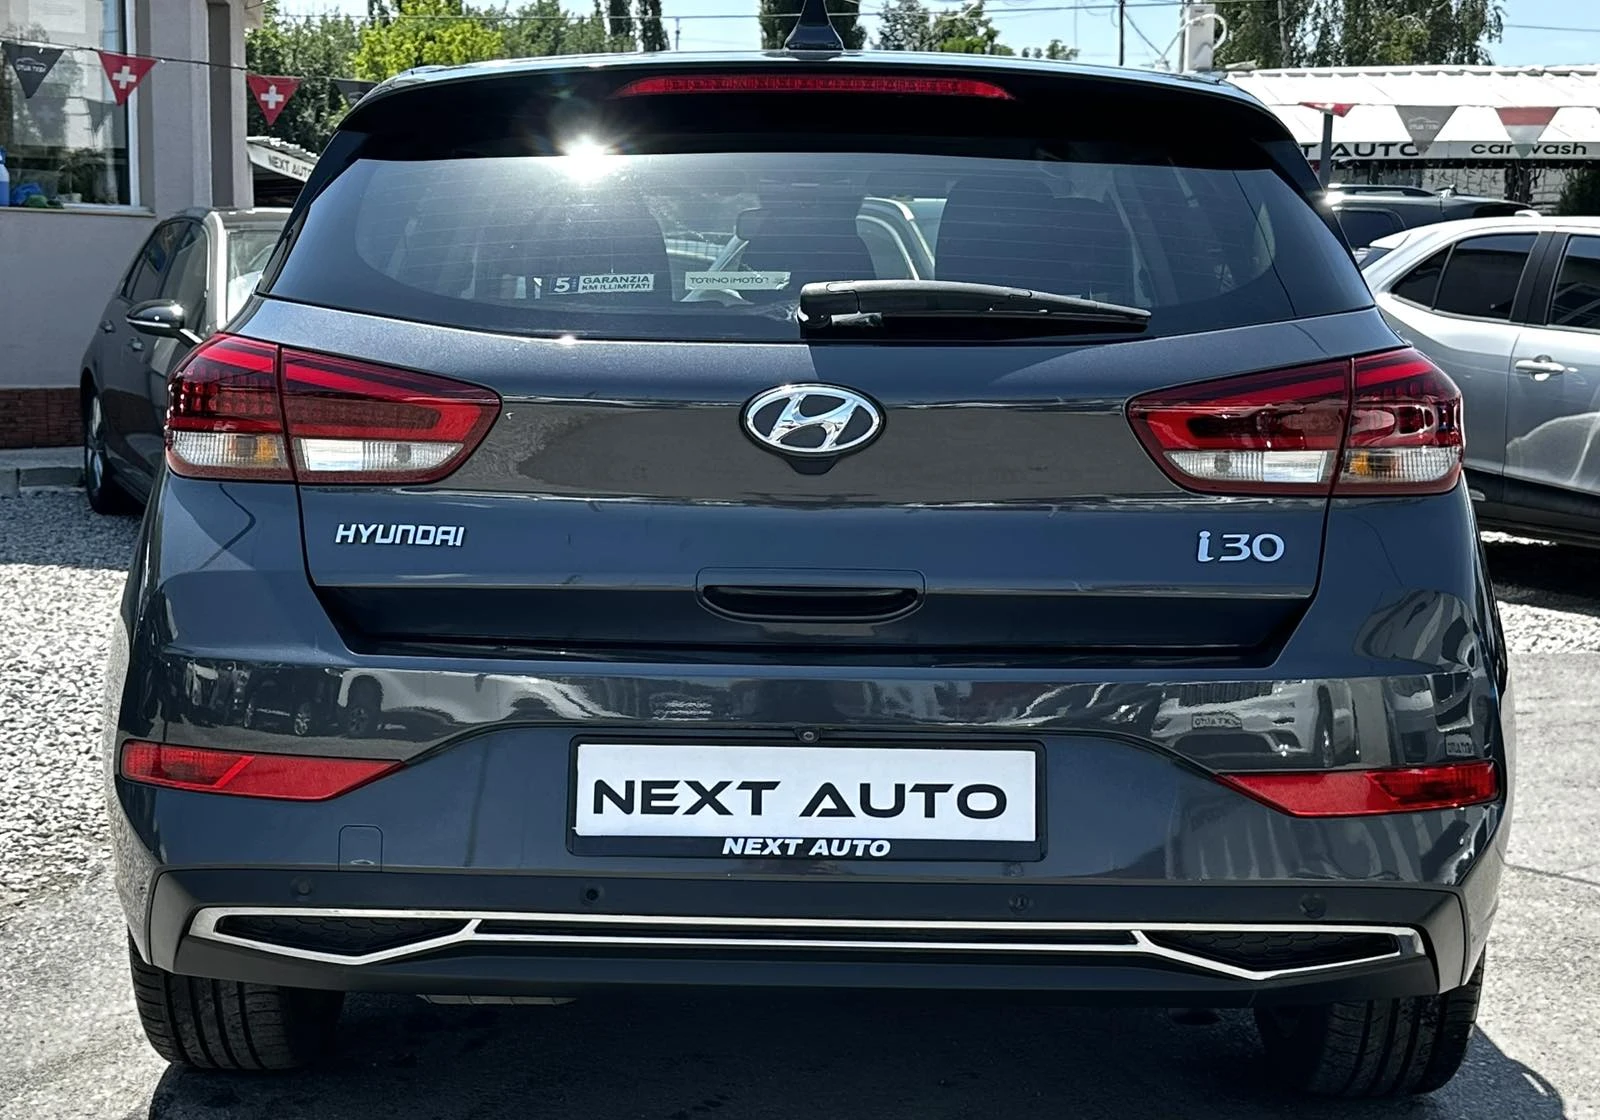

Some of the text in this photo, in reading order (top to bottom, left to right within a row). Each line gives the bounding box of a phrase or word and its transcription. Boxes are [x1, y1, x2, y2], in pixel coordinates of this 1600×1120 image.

[1331, 143, 1419, 157] AUTO
[1471, 143, 1514, 155] car
[553, 277, 571, 293] 5
[582, 275, 650, 285] GARANZIA
[689, 276, 729, 285] TORINO
[335, 523, 465, 546] HYUNDAI
[1197, 530, 1285, 562] i30
[593, 778, 1008, 820] NEXT AUTO
[722, 837, 891, 857] NEXT AUTO
